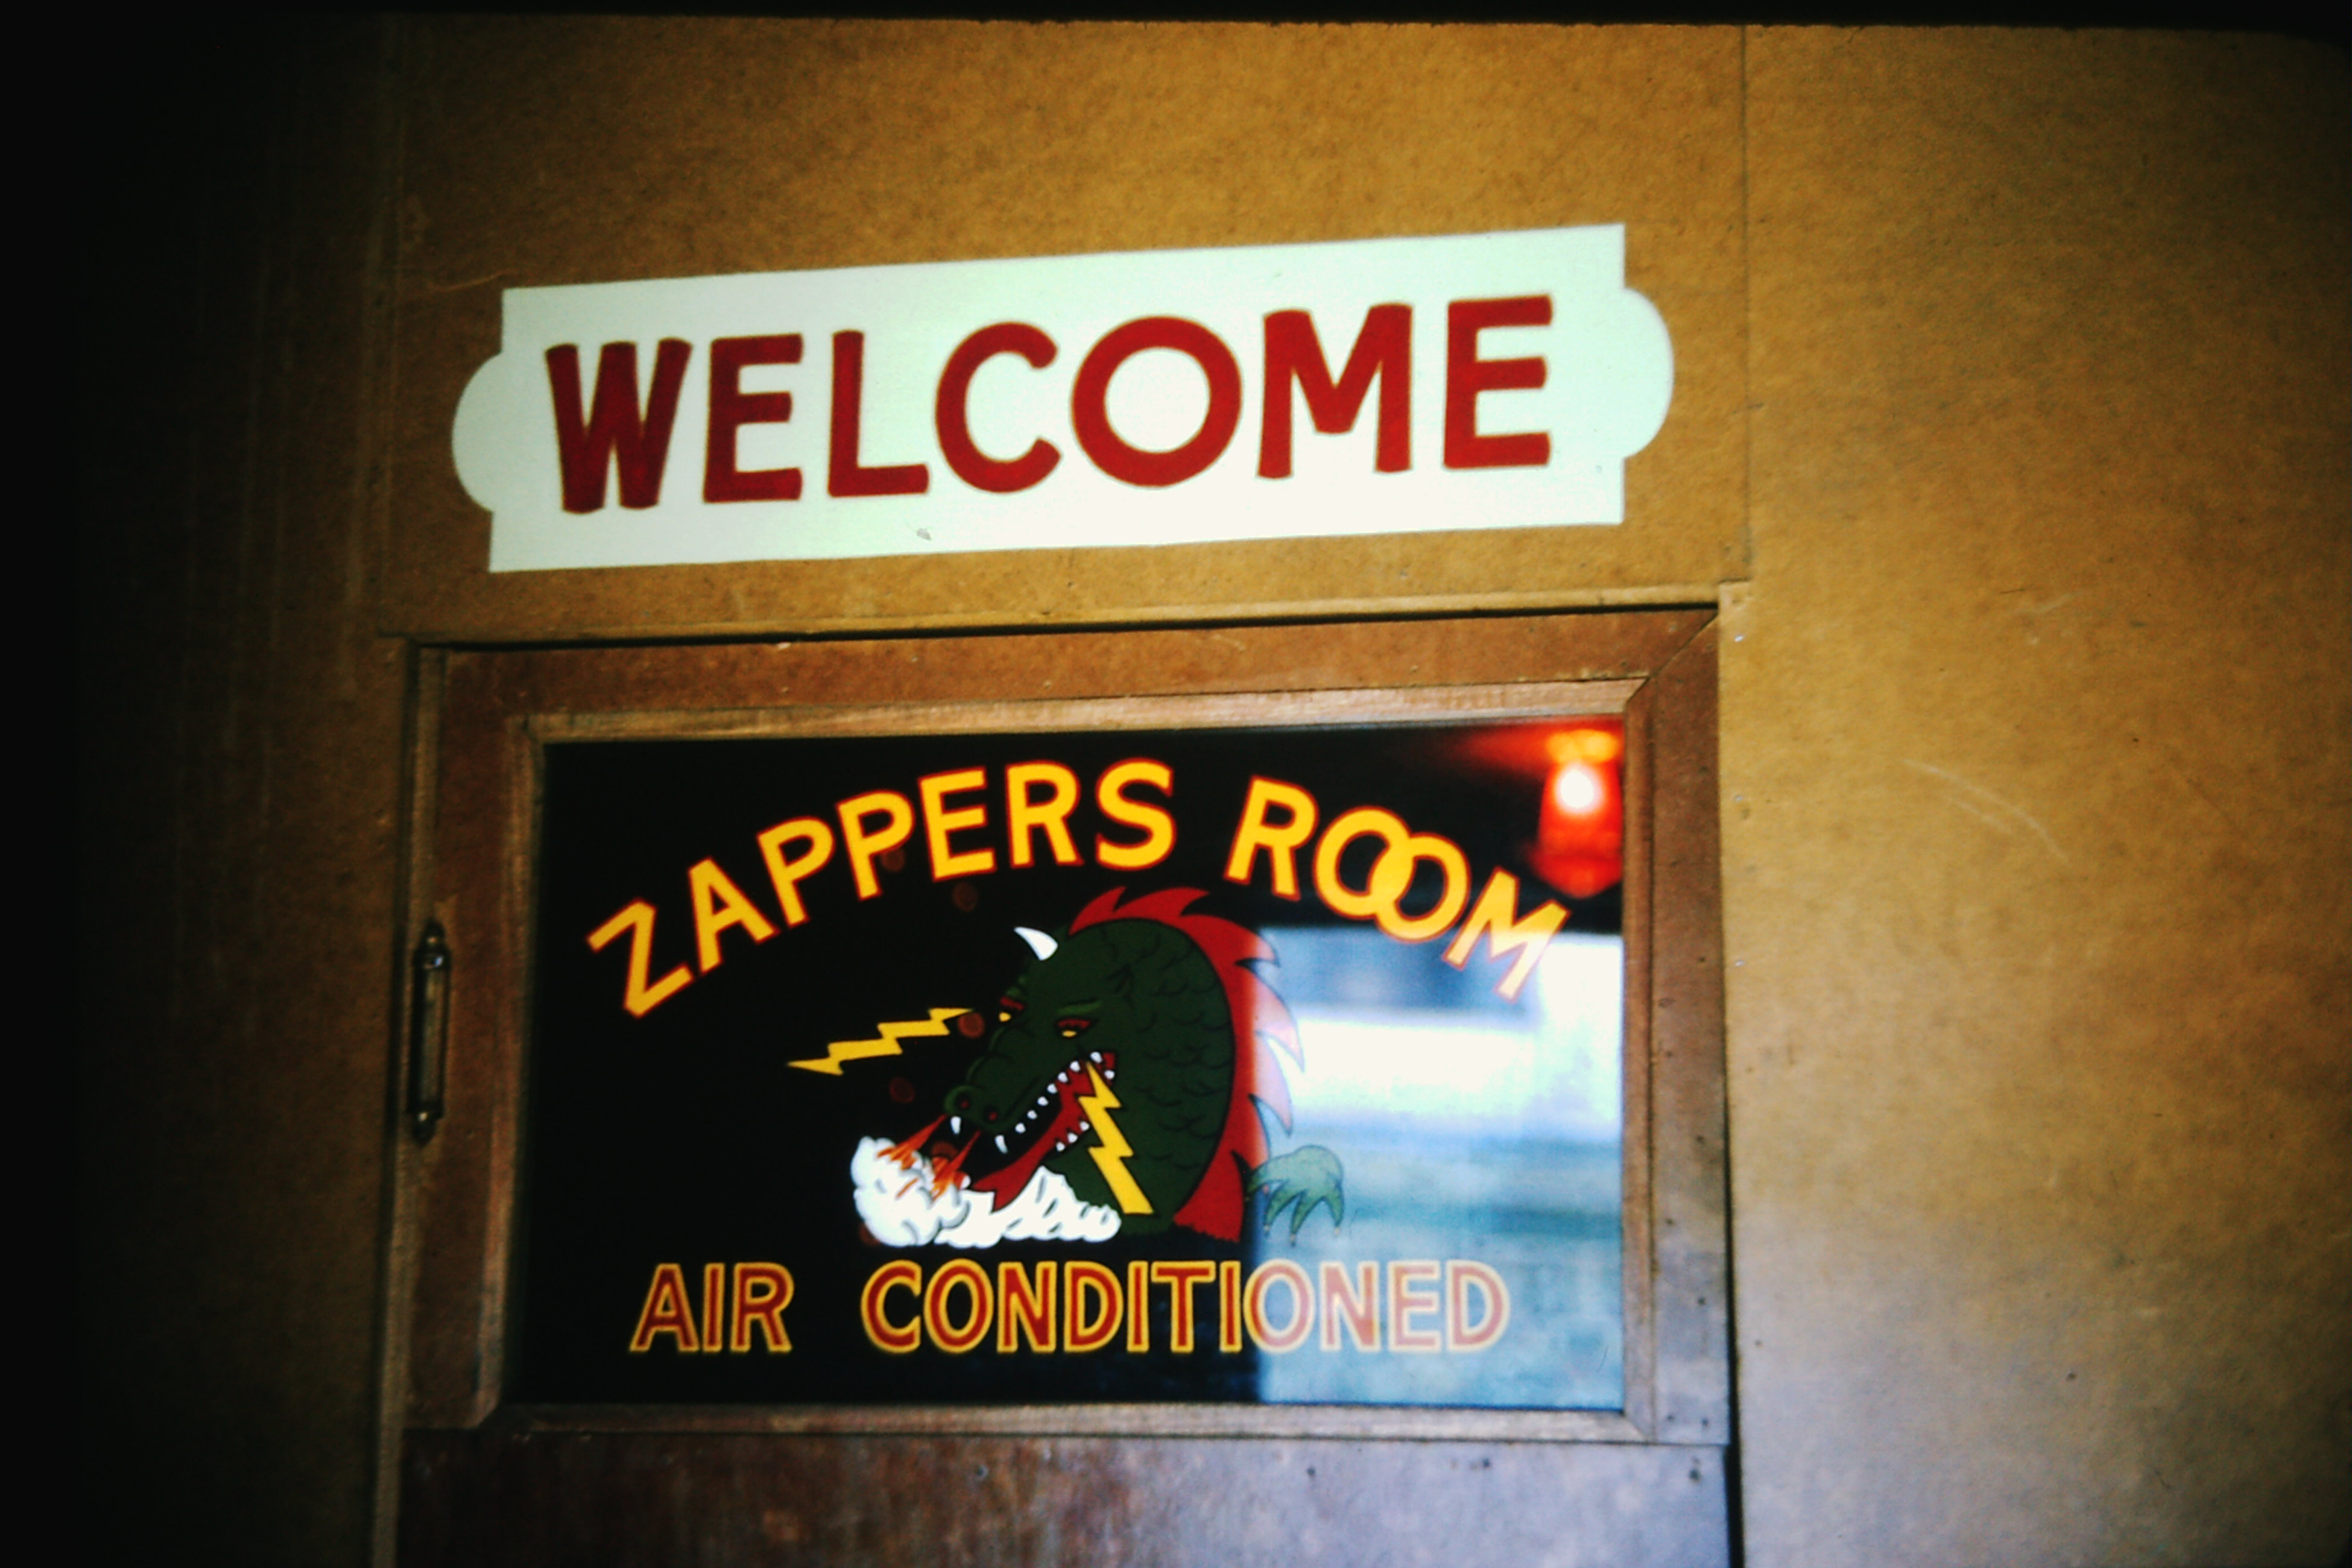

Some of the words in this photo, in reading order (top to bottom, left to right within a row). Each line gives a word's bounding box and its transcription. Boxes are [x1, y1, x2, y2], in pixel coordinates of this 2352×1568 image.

[545, 294, 1553, 514] WELCOME
[586, 757, 1176, 1018] ZAPPERS
[1224, 774, 1571, 1004] ROOM
[628, 1261, 795, 1353] AIR
[860, 1257, 1511, 1355] CONDITIONED
